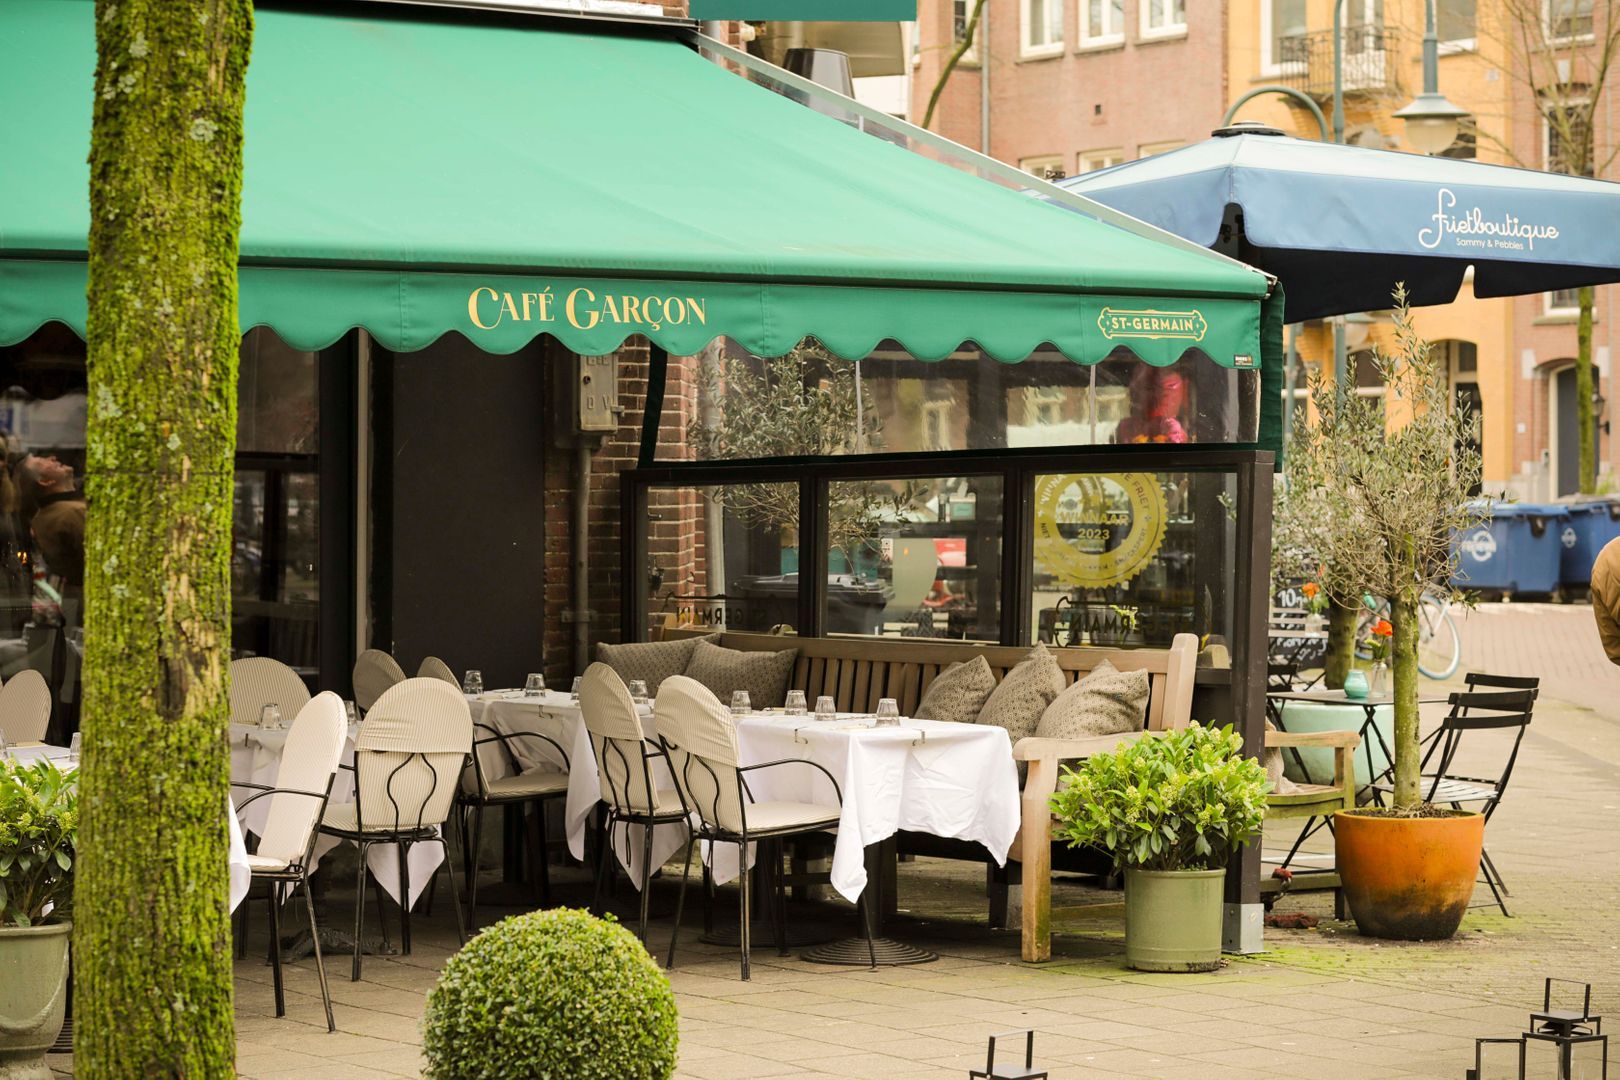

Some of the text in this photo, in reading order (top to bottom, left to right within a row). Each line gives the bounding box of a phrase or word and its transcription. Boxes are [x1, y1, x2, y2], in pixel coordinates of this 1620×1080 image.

[1456, 238, 1524, 250] Sammy & Pebbles
[468, 286, 706, 331] CAFÉ GARÇON
[1111, 317, 1195, 331] ST-GERMAIN
[1078, 528, 1110, 539] 2023
